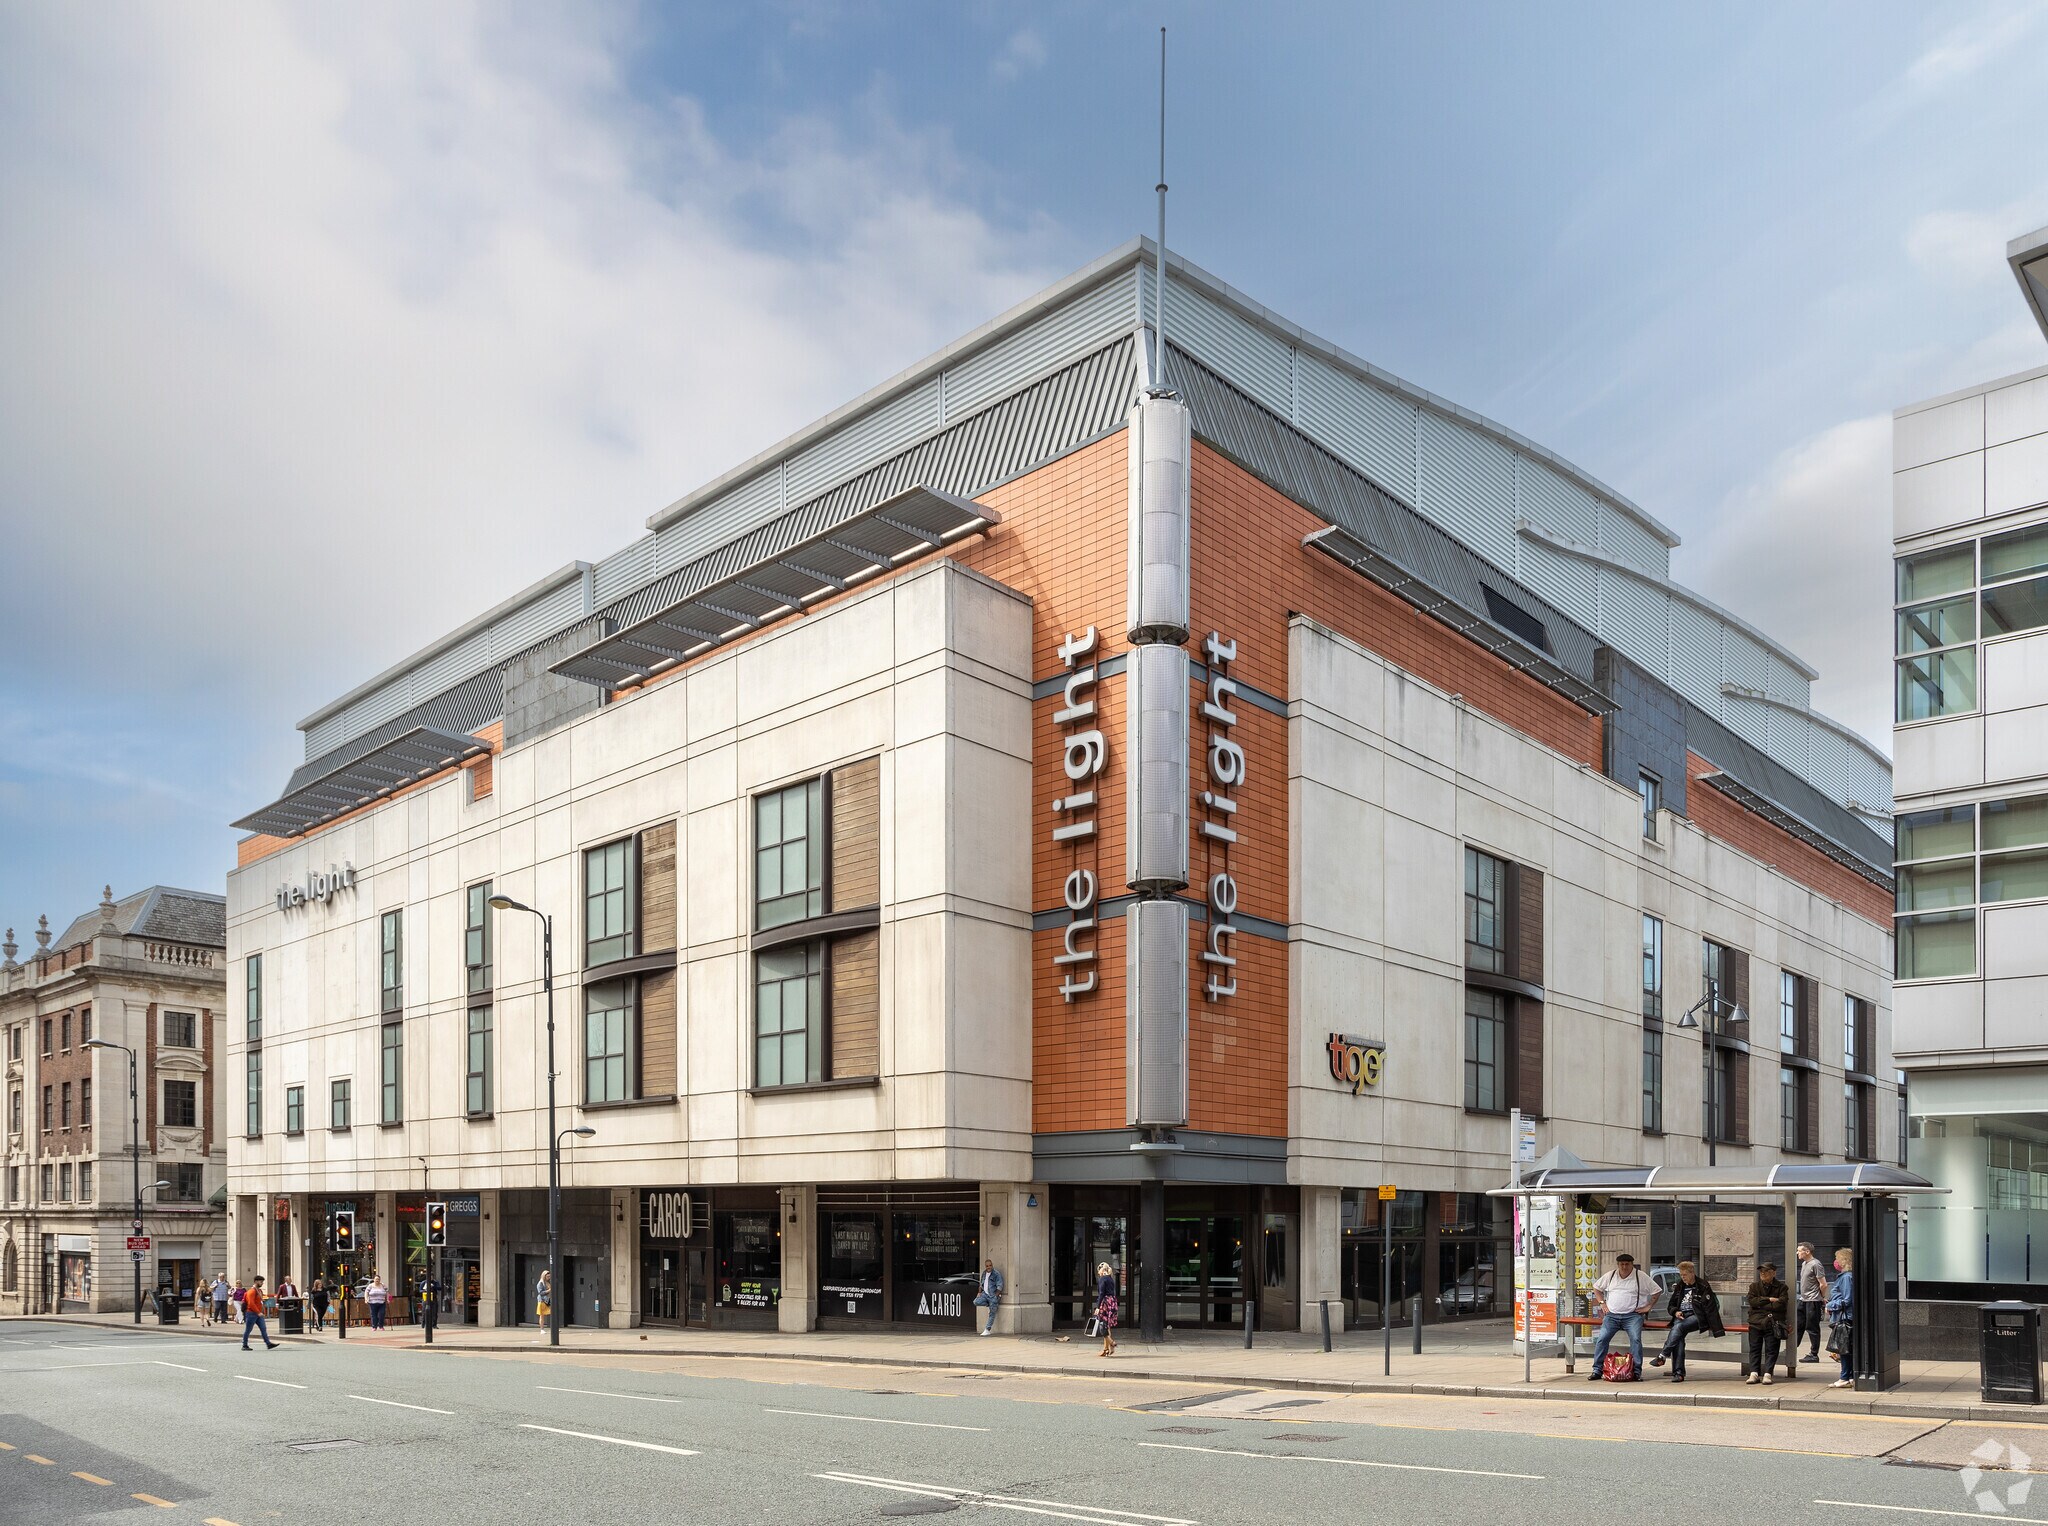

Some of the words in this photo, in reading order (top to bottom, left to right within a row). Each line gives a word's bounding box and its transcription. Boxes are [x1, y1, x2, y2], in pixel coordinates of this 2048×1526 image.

[1052, 625, 1108, 842] light
[1198, 630, 1245, 844] light
[276, 882, 305, 911] the
[305, 861, 354, 904] light
[1053, 869, 1099, 1004] the
[1198, 872, 1238, 1004] the
[449, 1200, 478, 1212] GREGGS
[649, 1192, 692, 1239] CARGO
[931, 1292, 961, 1317] CARGO
